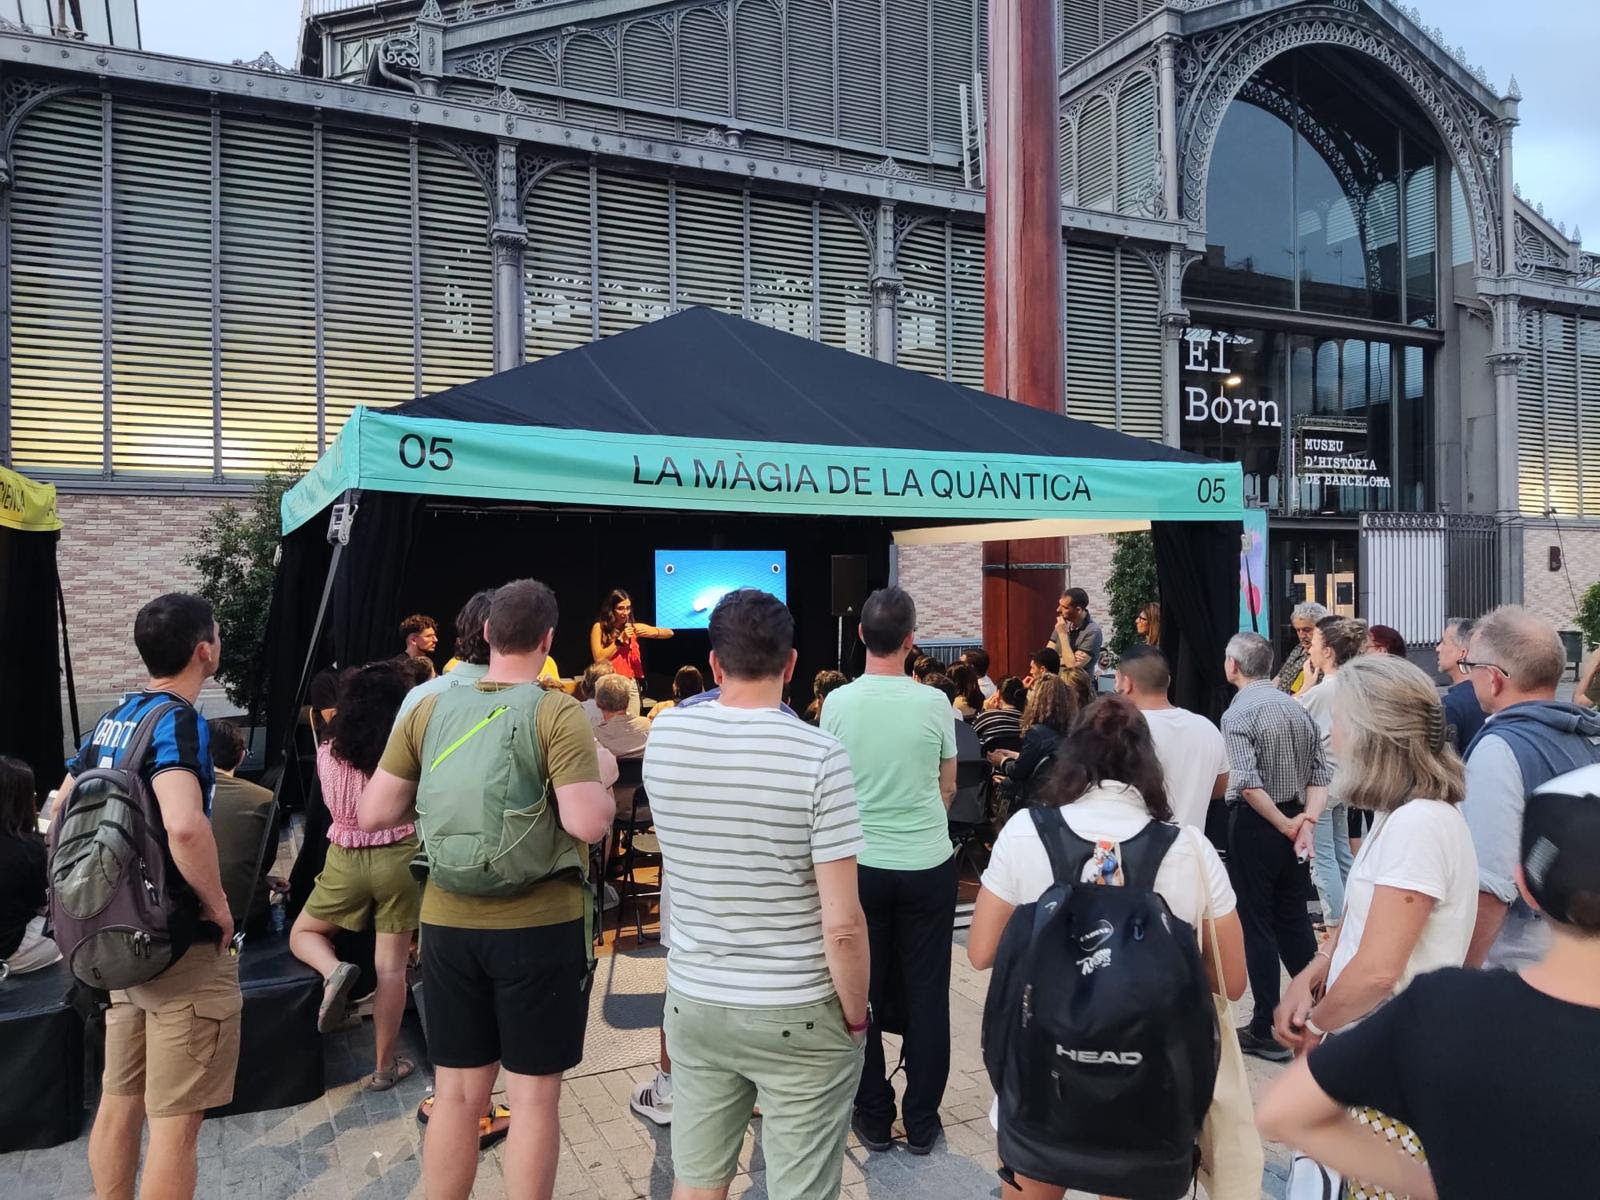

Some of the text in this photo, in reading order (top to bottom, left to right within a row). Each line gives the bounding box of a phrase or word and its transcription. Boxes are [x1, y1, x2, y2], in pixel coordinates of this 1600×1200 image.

[1184, 335, 1231, 373] El
[1184, 386, 1282, 427] Born
[399, 433, 454, 471] 05
[1304, 438, 1344, 452] MUSEU
[1304, 454, 1377, 471] D'HISTÒRIA
[633, 452, 1092, 501] LA MÀGIA DE LA QUÀNTICA
[1304, 473, 1391, 488] DE BARCELONA
[1197, 477, 1226, 504] 05
[1055, 1043, 1143, 1065] HEAD
